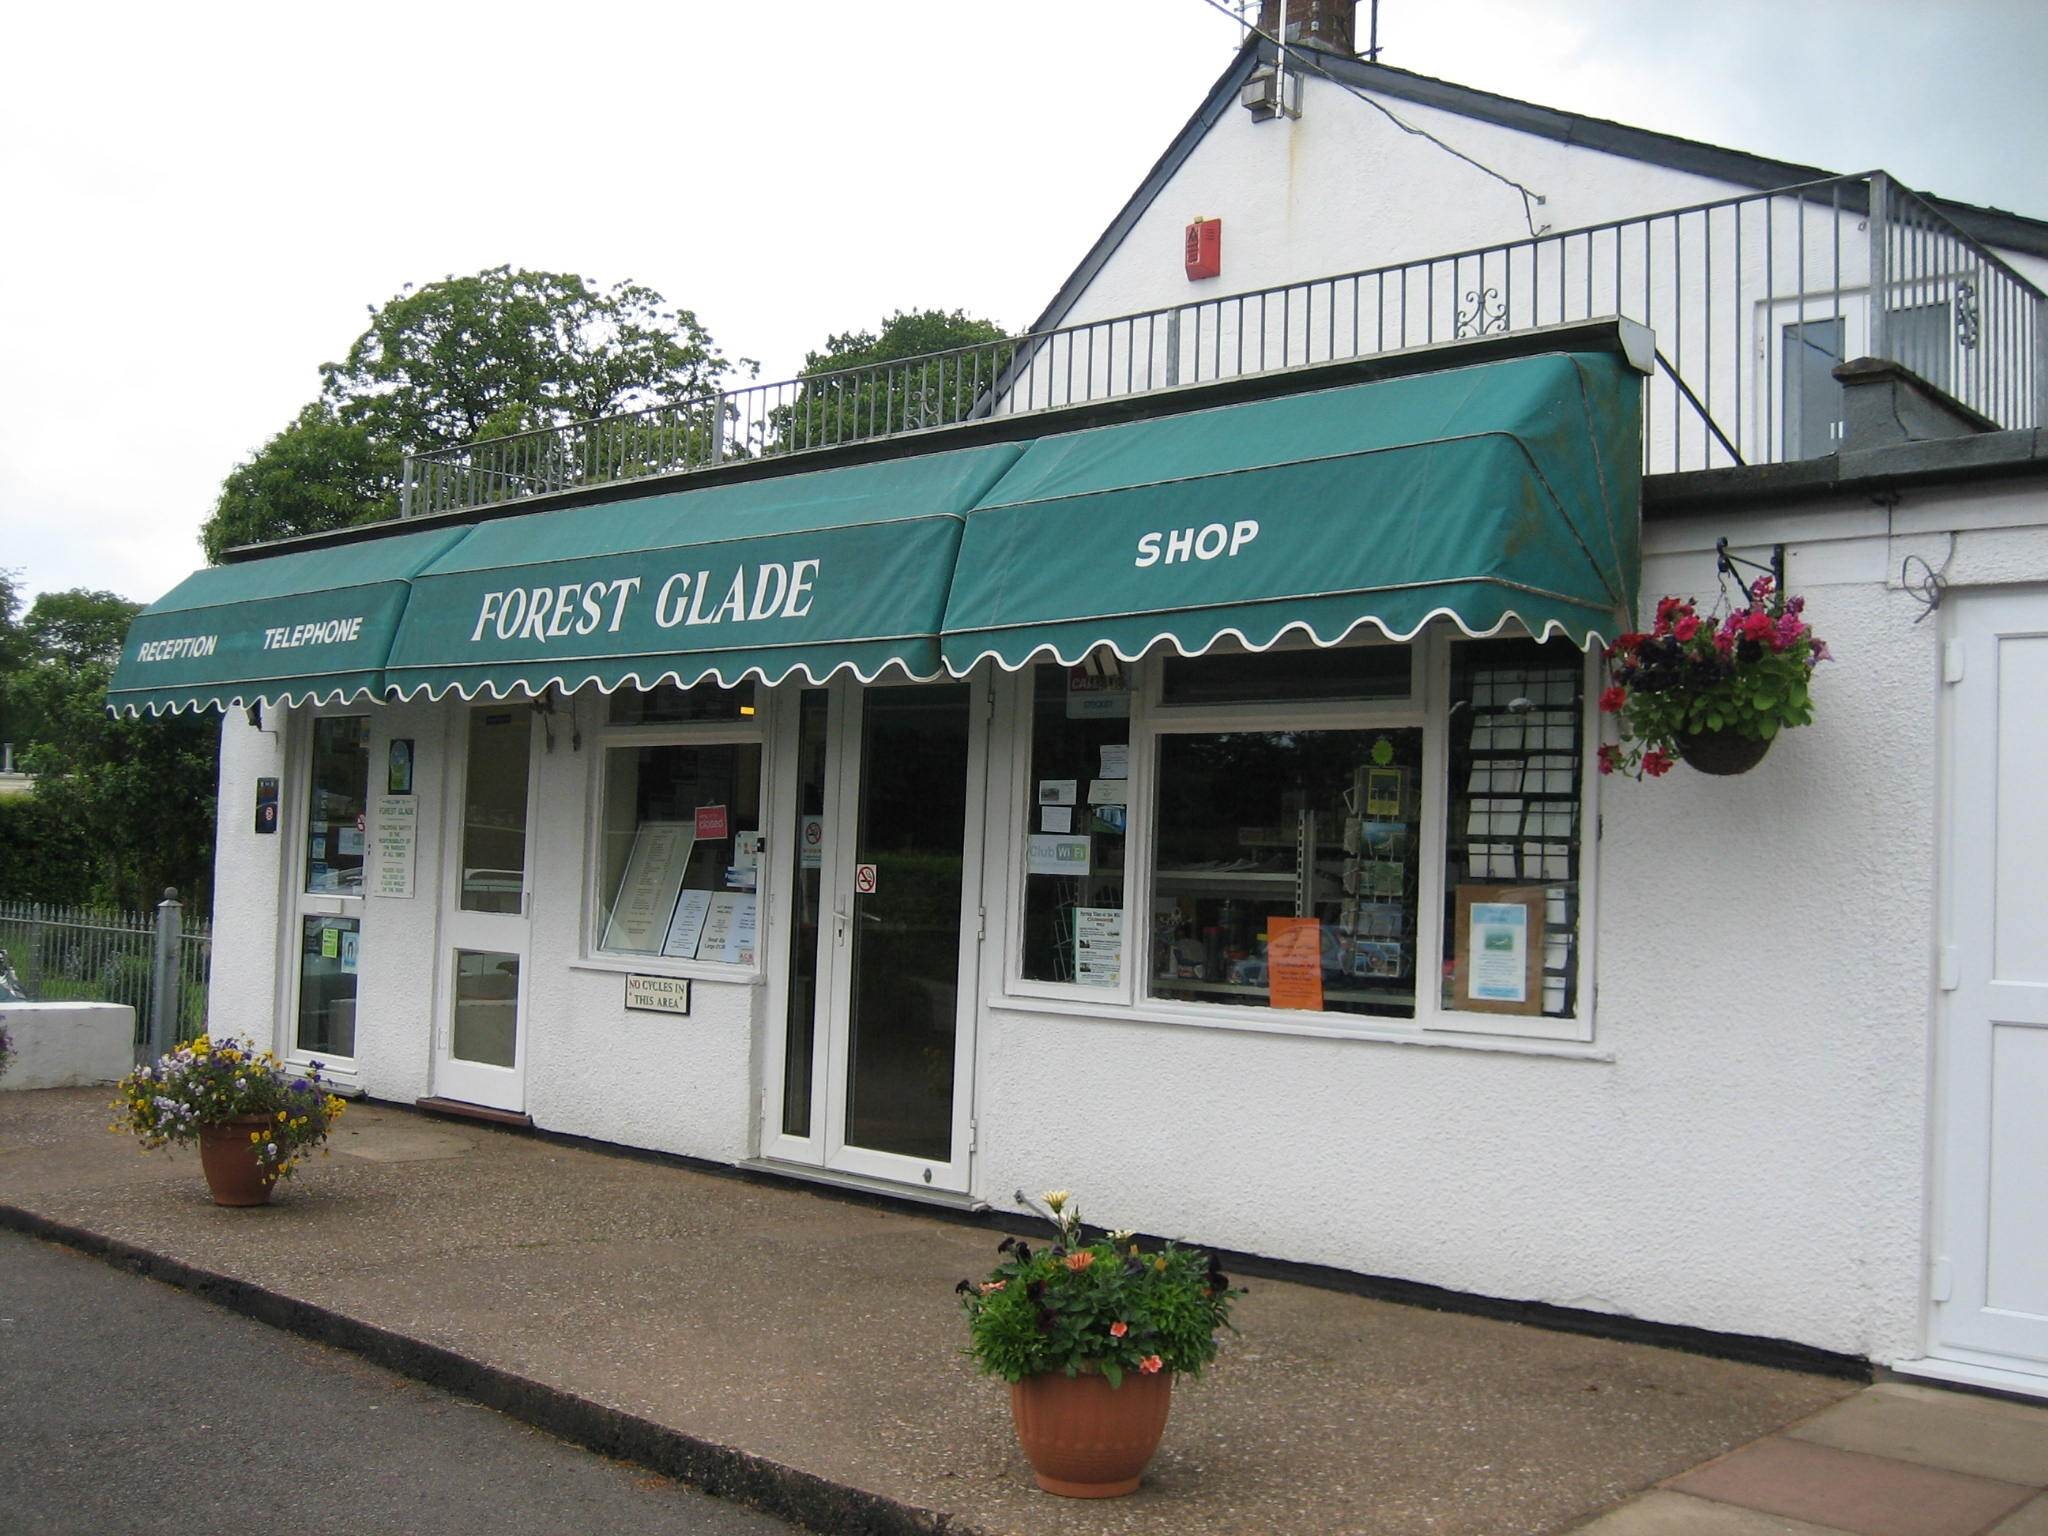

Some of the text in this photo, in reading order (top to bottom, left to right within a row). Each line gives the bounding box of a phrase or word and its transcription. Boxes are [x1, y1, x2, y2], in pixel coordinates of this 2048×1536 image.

[1134, 519, 1260, 568] SHOP
[470, 558, 821, 644] FOREST GLADE
[263, 616, 364, 650] TELEPHONE
[136, 635, 218, 662] RECEPTION
[378, 808, 396, 816] FOREST
[1030, 845, 1055, 858] Club
[629, 979, 685, 994] NO CYCLES IN
[634, 995, 679, 1008] THIS AREA
